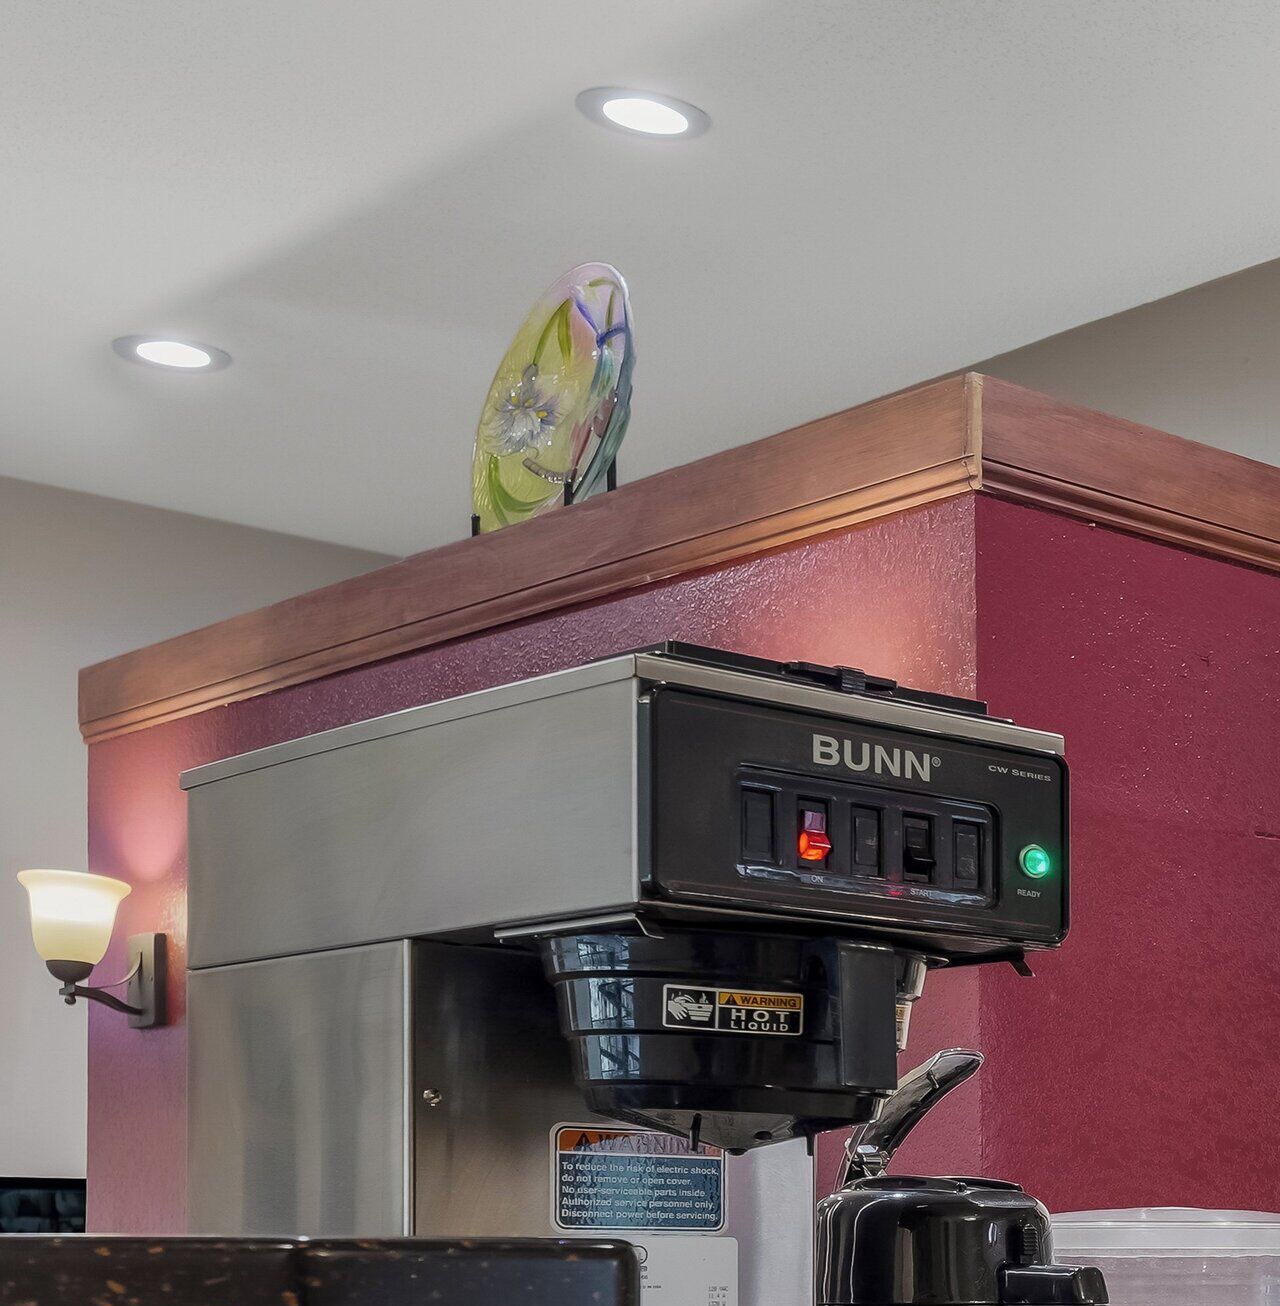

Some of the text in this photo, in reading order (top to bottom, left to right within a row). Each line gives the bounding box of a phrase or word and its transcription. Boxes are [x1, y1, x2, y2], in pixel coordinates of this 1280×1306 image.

[812, 734, 931, 782] BUNN
[988, 765, 1052, 782] CW SERIES
[811, 875, 824, 884] ON
[910, 887, 932, 897] START
[1017, 888, 1041, 898] READY
[740, 996, 797, 1008] WARNING
[731, 1009, 790, 1023] HOT
[730, 1020, 789, 1032] LIQUID
[562, 1161, 719, 1176] To reduce the risk of electric shock,
[562, 1174, 574, 1182] do
[576, 1174, 592, 1182] not
[594, 1176, 628, 1184] remove
[642, 1178, 664, 1186] open
[666, 1178, 692, 1186] cover.
[562, 1185, 707, 1200] No user-serviceable parts inside.
[562, 1197, 612, 1206] Authorized
[648, 1200, 693, 1211] personnel
[694, 1201, 715, 1210] only.
[562, 1209, 718, 1221] Disconnect power before servicing.
